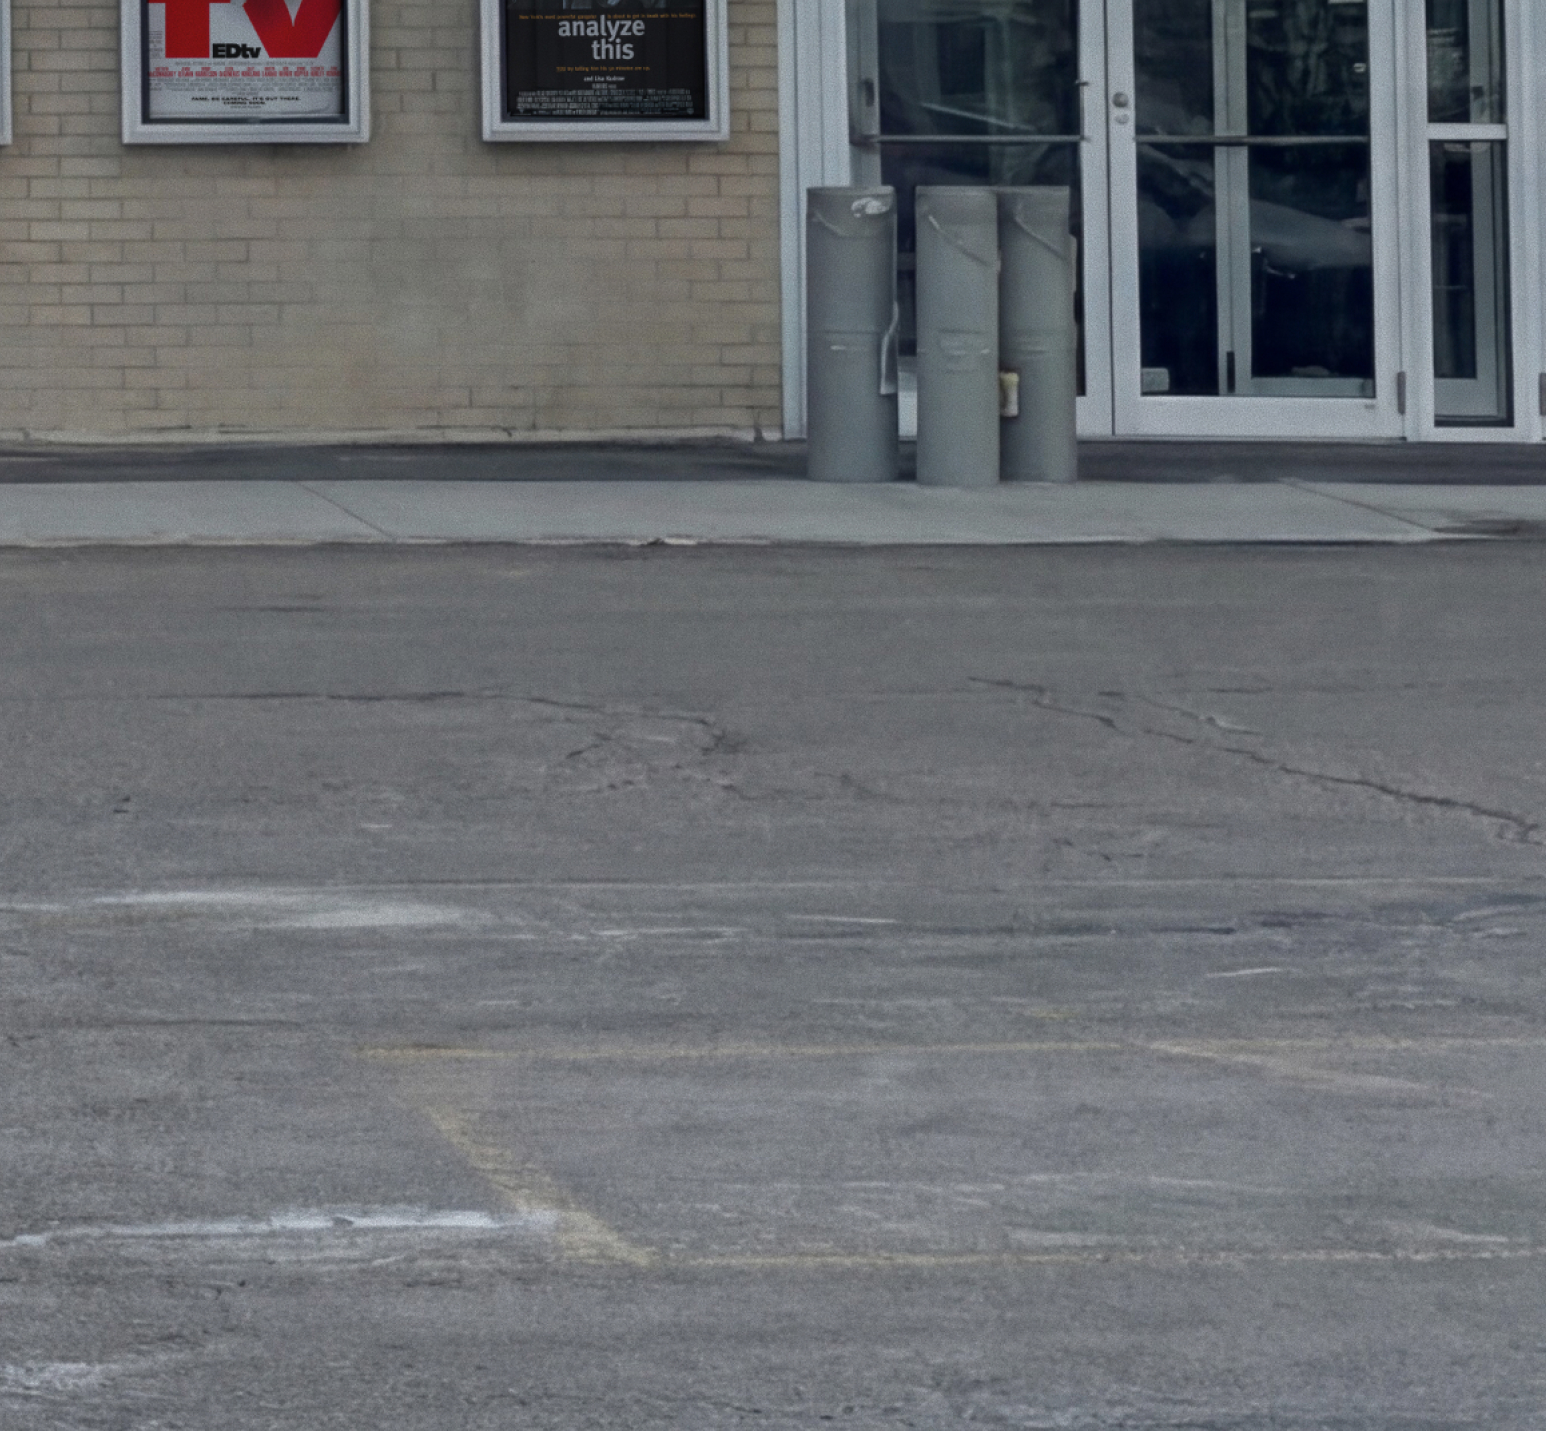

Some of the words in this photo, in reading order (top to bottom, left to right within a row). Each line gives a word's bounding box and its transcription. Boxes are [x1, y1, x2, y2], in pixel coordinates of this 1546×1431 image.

[558, 14, 646, 42] analyze
[212, 43, 261, 59] EDtv
[591, 38, 635, 60] this
